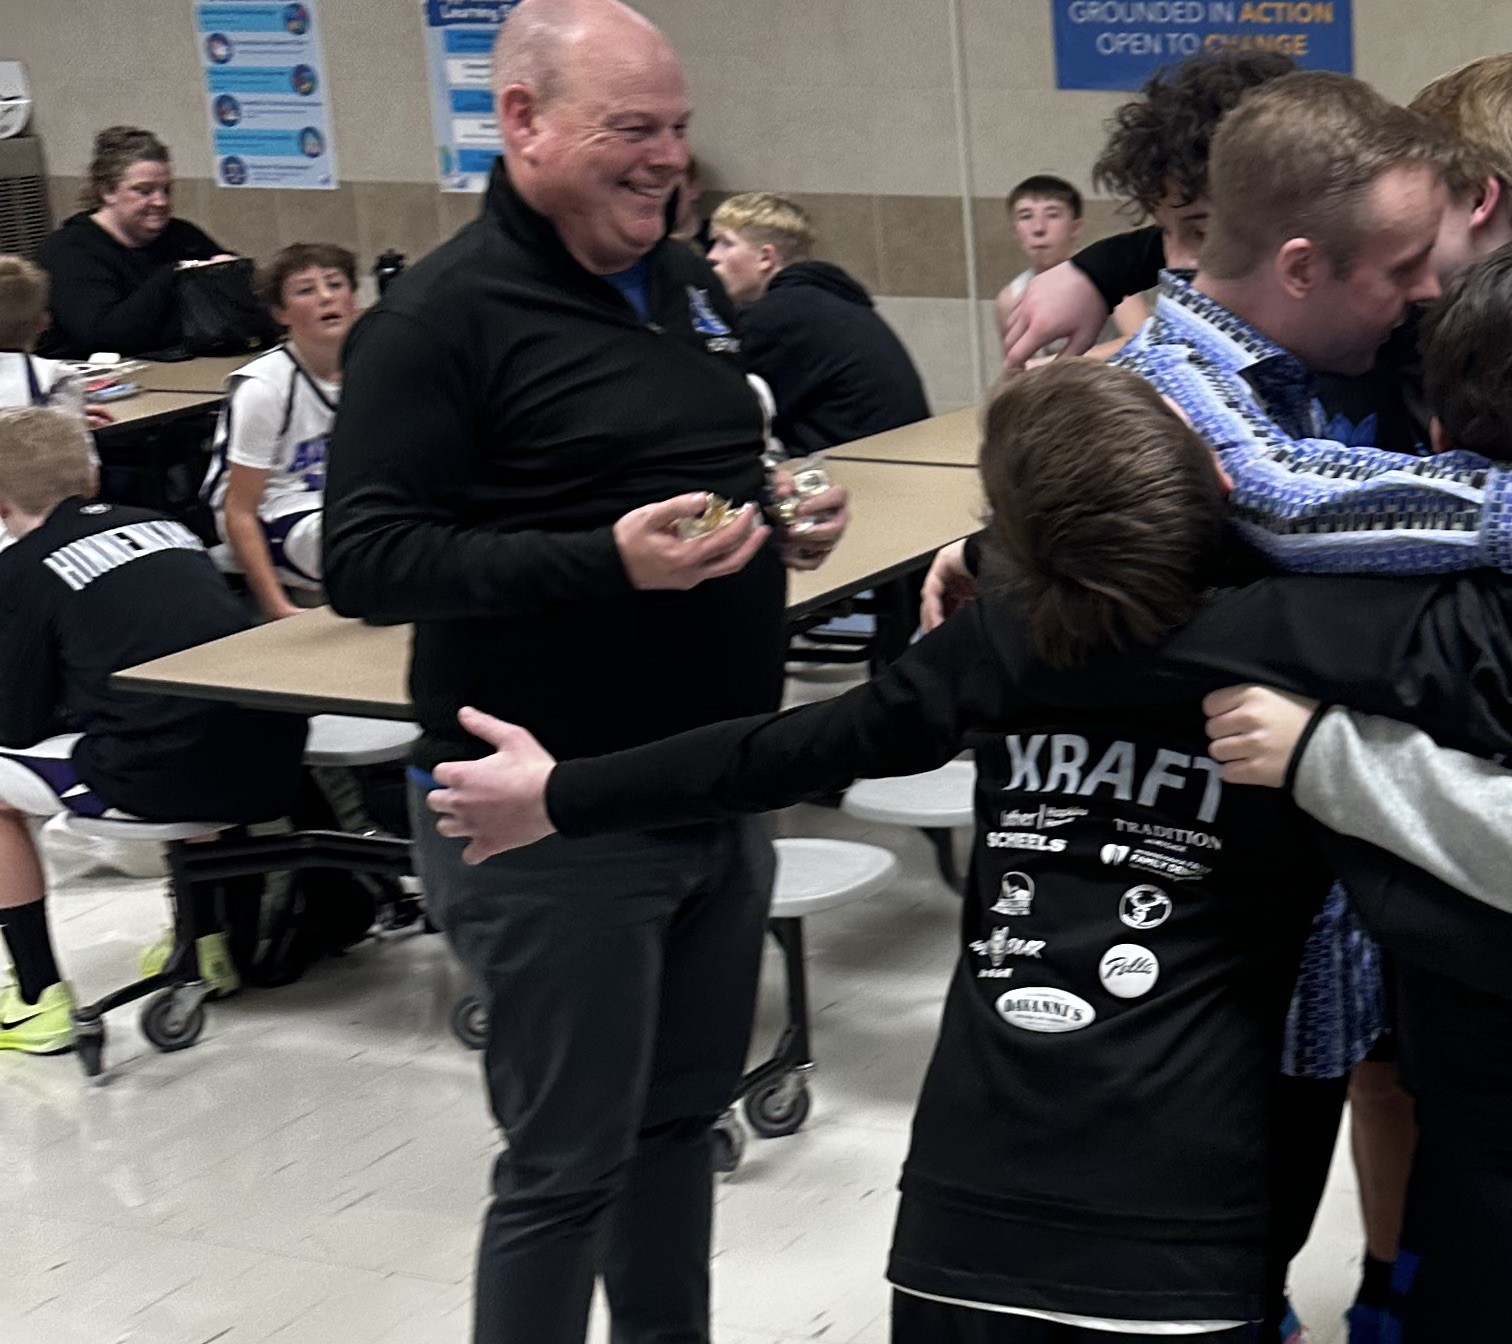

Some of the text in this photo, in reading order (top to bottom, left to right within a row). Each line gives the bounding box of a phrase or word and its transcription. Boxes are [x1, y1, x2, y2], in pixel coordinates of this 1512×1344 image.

[1068, 1, 1335, 24] GROUNDED IN ACTION
[1096, 32, 1163, 55] OPEN
[1164, 32, 1201, 55] TO
[986, 831, 1069, 853] SCHEELS
[1112, 817, 1223, 852] TRADITION
